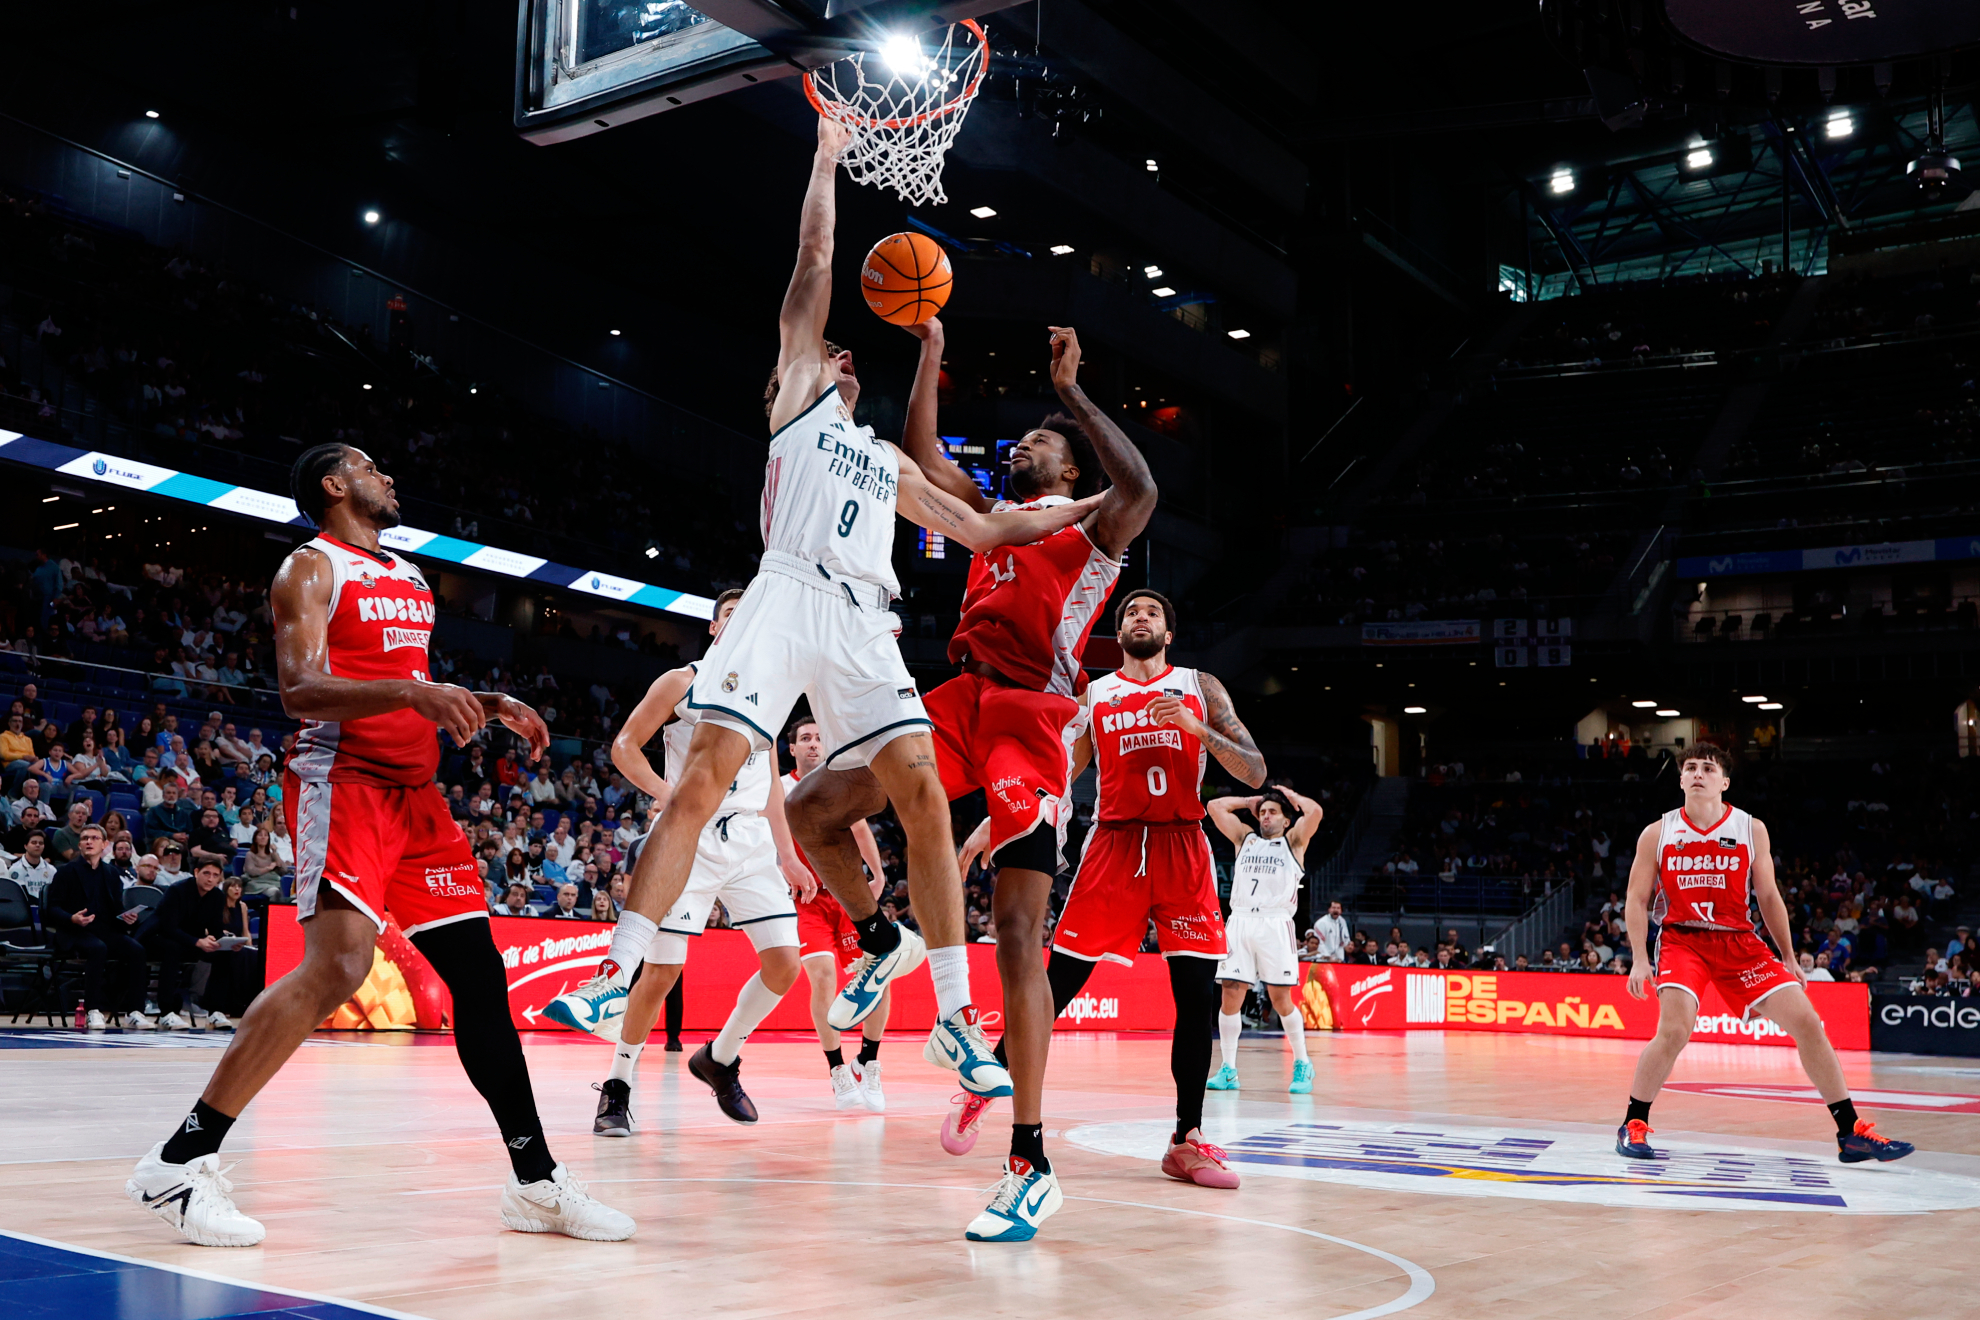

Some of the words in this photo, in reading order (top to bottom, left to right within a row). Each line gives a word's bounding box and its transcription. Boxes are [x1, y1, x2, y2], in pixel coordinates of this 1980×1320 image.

[817, 431, 897, 497] Emirates
[828, 457, 852, 478] FLY
[852, 471, 890, 505] BETTER
[837, 499, 860, 538] 9
[383, 532, 411, 543] FLUGE
[386, 629, 430, 648] MANRES
[1121, 732, 1180, 752] MANRESA
[1147, 766, 1168, 796] 0
[1240, 854, 1285, 867] Emirates
[1667, 854, 1741, 871] KIDS&US
[1242, 865, 1253, 873] FLY
[1254, 865, 1277, 875] BETTER
[425, 873, 457, 887] ETL
[1250, 878, 1259, 896] 7
[1679, 875, 1724, 887] MANRESA
[430, 885, 481, 897] GLOBAL
[842, 936, 857, 947] ETL
[522, 944, 540, 964] de
[1744, 971, 1778, 989] GLOBAL
[1406, 974, 1446, 1023] MANGO
[1447, 974, 1497, 999] DE
[1446, 996, 1625, 1030] ESPAÑA
